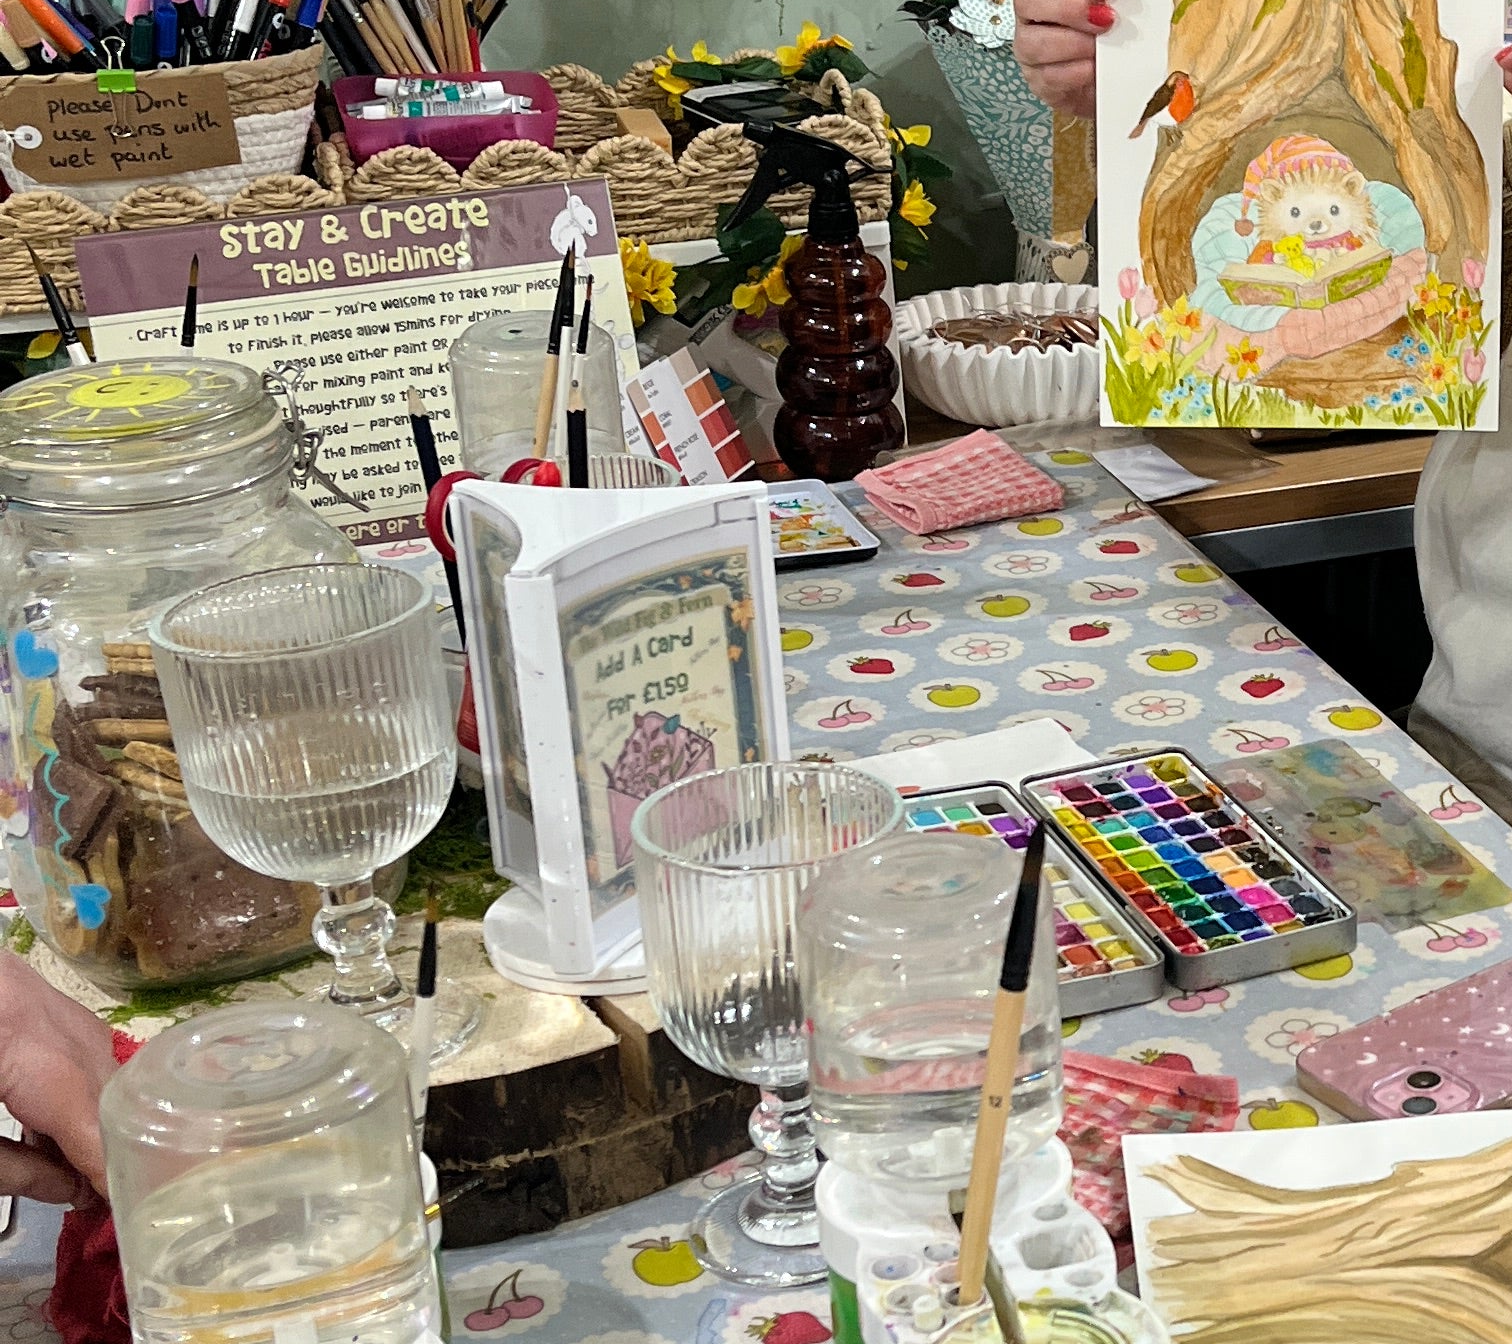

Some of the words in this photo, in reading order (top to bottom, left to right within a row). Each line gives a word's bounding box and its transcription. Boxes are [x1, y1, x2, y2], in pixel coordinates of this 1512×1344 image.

[48, 99, 114, 122] please
[53, 128, 97, 142] use
[174, 110, 222, 134] with
[50, 147, 97, 169] wet
[109, 142, 174, 172] paint
[219, 218, 305, 260] Stay
[320, 213, 350, 245] &
[359, 197, 490, 241] Create
[252, 254, 336, 290] Table
[344, 240, 474, 278] Guidlines
[136, 327, 178, 343] Craft
[218, 318, 230, 332] is
[233, 315, 250, 332] up
[254, 313, 270, 328] to
[283, 308, 315, 324] hour
[336, 300, 378, 317] you're
[380, 292, 436, 309] welcome
[439, 289, 455, 303] to
[458, 285, 489, 302] take
[491, 281, 522, 298] your
[526, 277, 559, 294] piece
[228, 341, 244, 355] to
[356, 322, 391, 337] allow
[394, 317, 437, 334] 15mins
[468, 308, 511, 323] dryin
[273, 356, 317, 373] Pease
[320, 353, 344, 366] use
[347, 346, 390, 363] either
[394, 340, 428, 358] paint
[432, 338, 449, 351] OR
[322, 374, 366, 390] mixing
[371, 367, 405, 385] paint
[408, 363, 434, 377] and
[297, 394, 377, 416] houghtfully
[380, 392, 396, 405] so
[399, 384, 448, 402] tere's
[369, 414, 410, 432] paren
[427, 408, 451, 421] are
[322, 444, 347, 459] the
[350, 437, 402, 455] moment
[342, 468, 359, 481] be
[362, 459, 401, 477] asked
[404, 459, 419, 471] to
[352, 489, 376, 503] like
[379, 485, 395, 498] to
[396, 481, 422, 499] join
[386, 516, 409, 534] or
[595, 651, 626, 684] Add
[631, 644, 644, 667] A
[648, 625, 694, 657] Card
